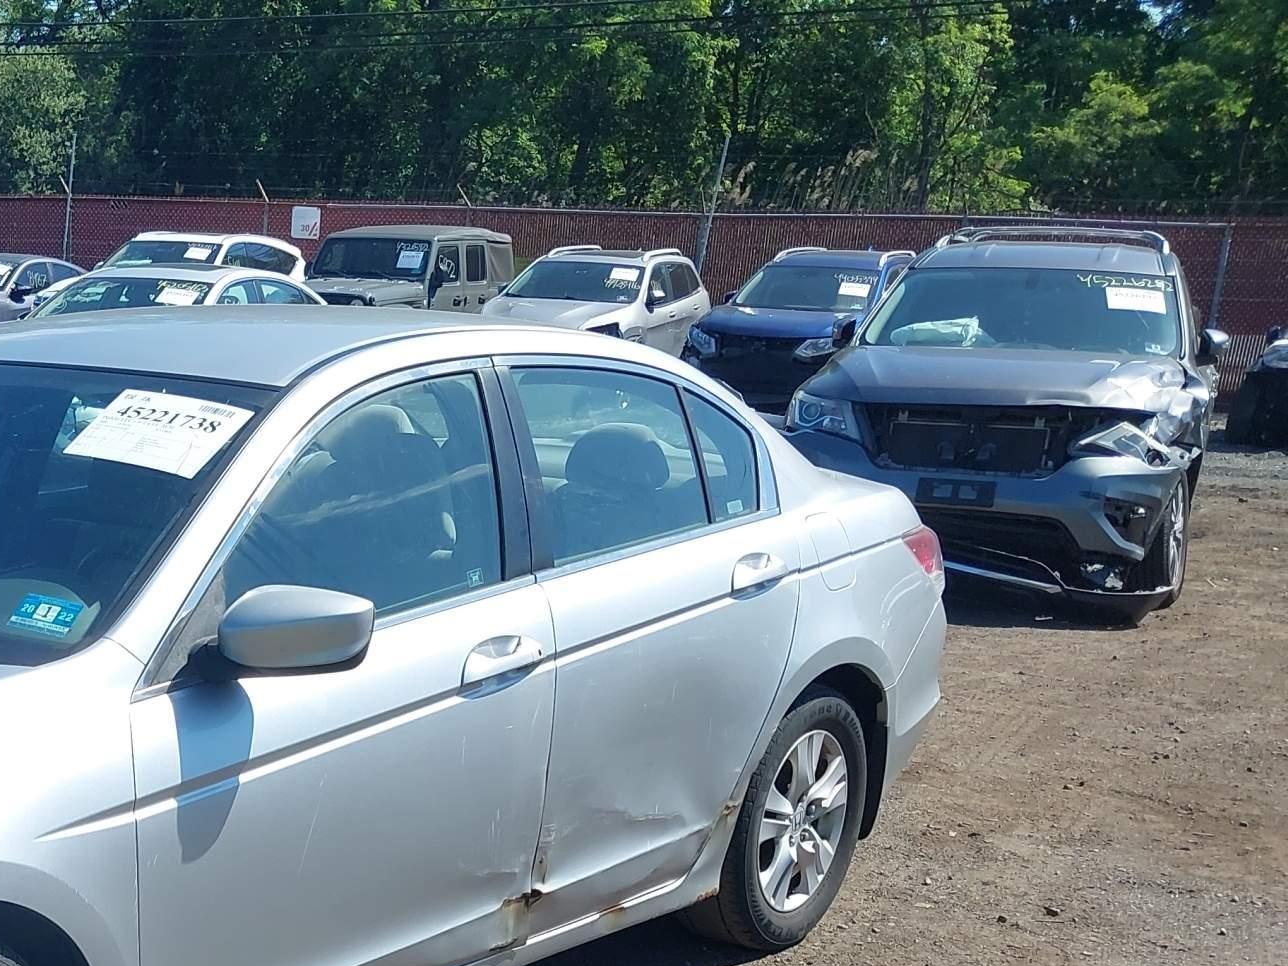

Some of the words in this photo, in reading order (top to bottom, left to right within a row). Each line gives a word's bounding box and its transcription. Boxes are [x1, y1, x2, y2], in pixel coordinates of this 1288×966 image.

[116, 404, 223, 435] 45221738
[20, 603, 36, 614] 20
[41, 606, 53, 618] 1
[57, 611, 74, 622] 22
